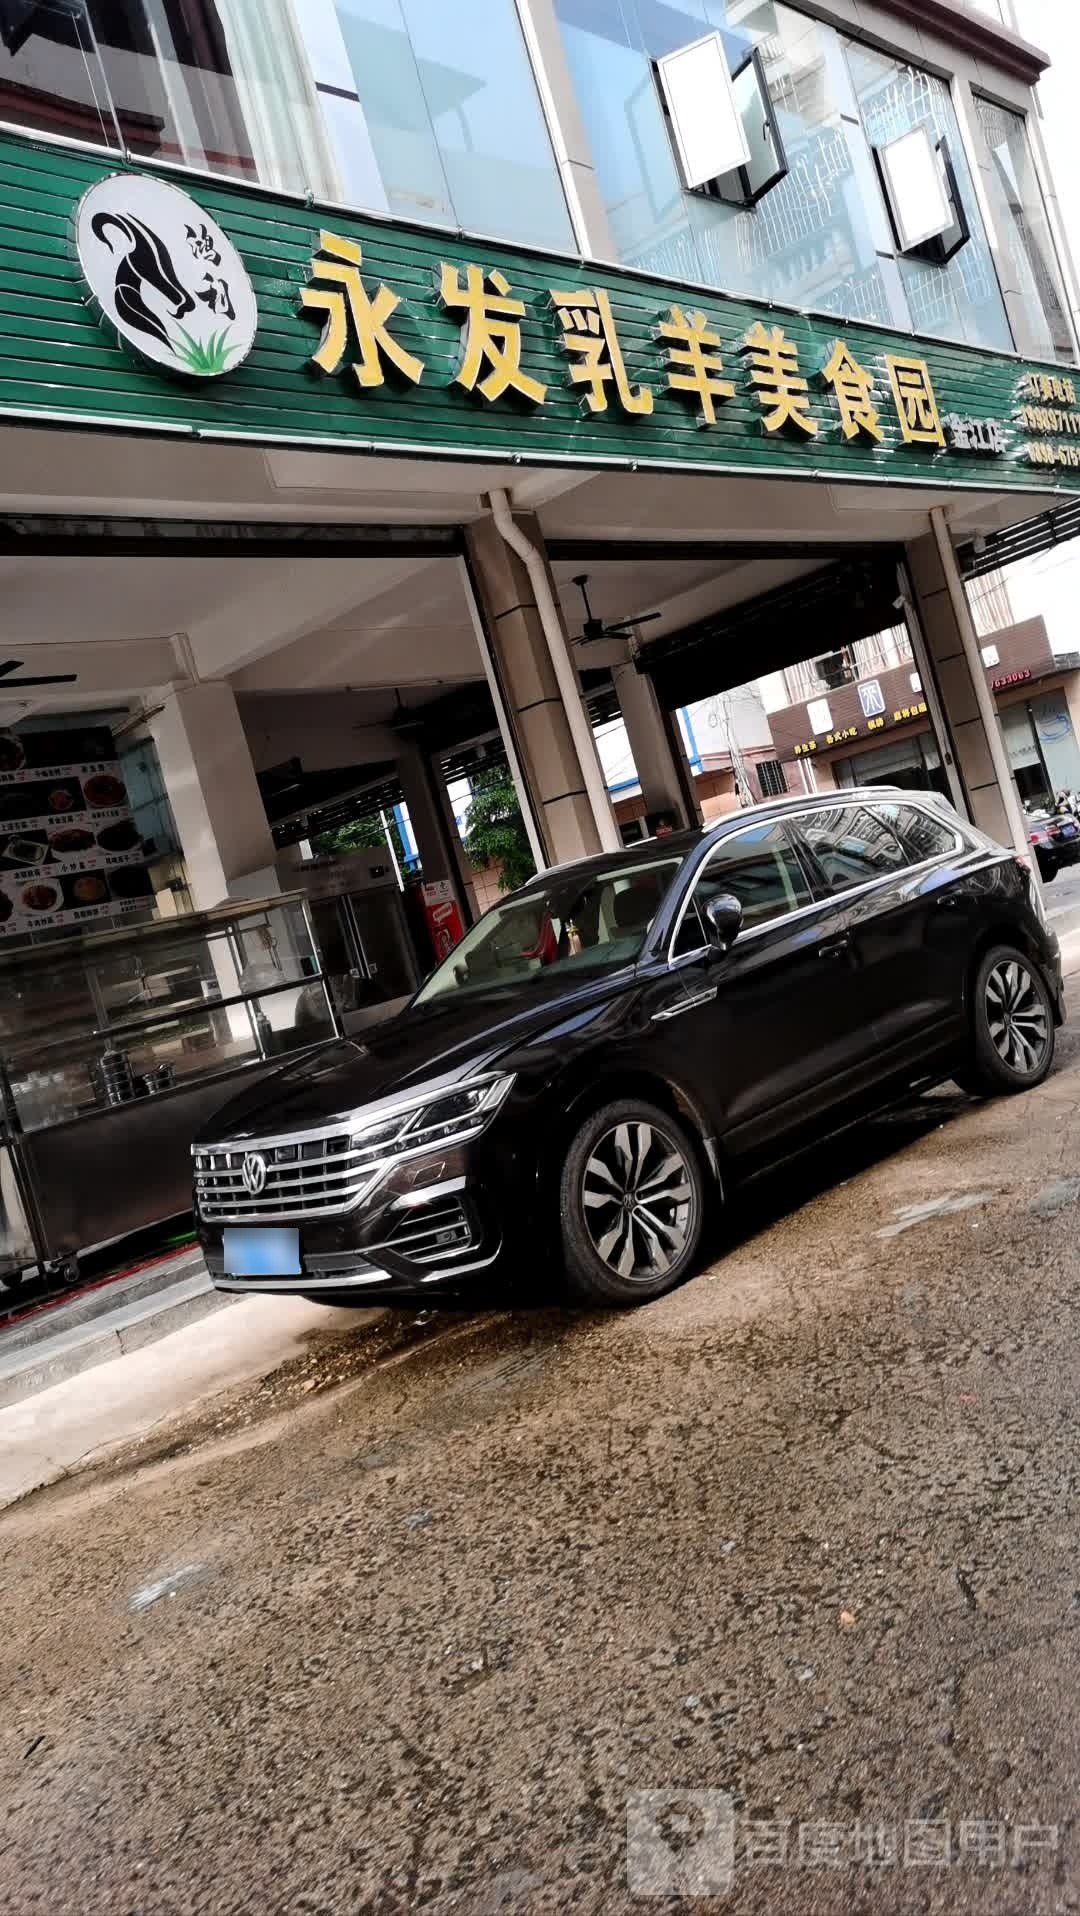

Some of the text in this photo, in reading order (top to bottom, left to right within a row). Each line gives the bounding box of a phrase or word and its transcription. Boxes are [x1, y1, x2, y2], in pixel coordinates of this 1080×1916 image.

[185, 224, 236, 320] 鸿利
[299, 229, 947, 449] 永发乳羊美食园
[825, 726, 858, 744] 各式小吃
